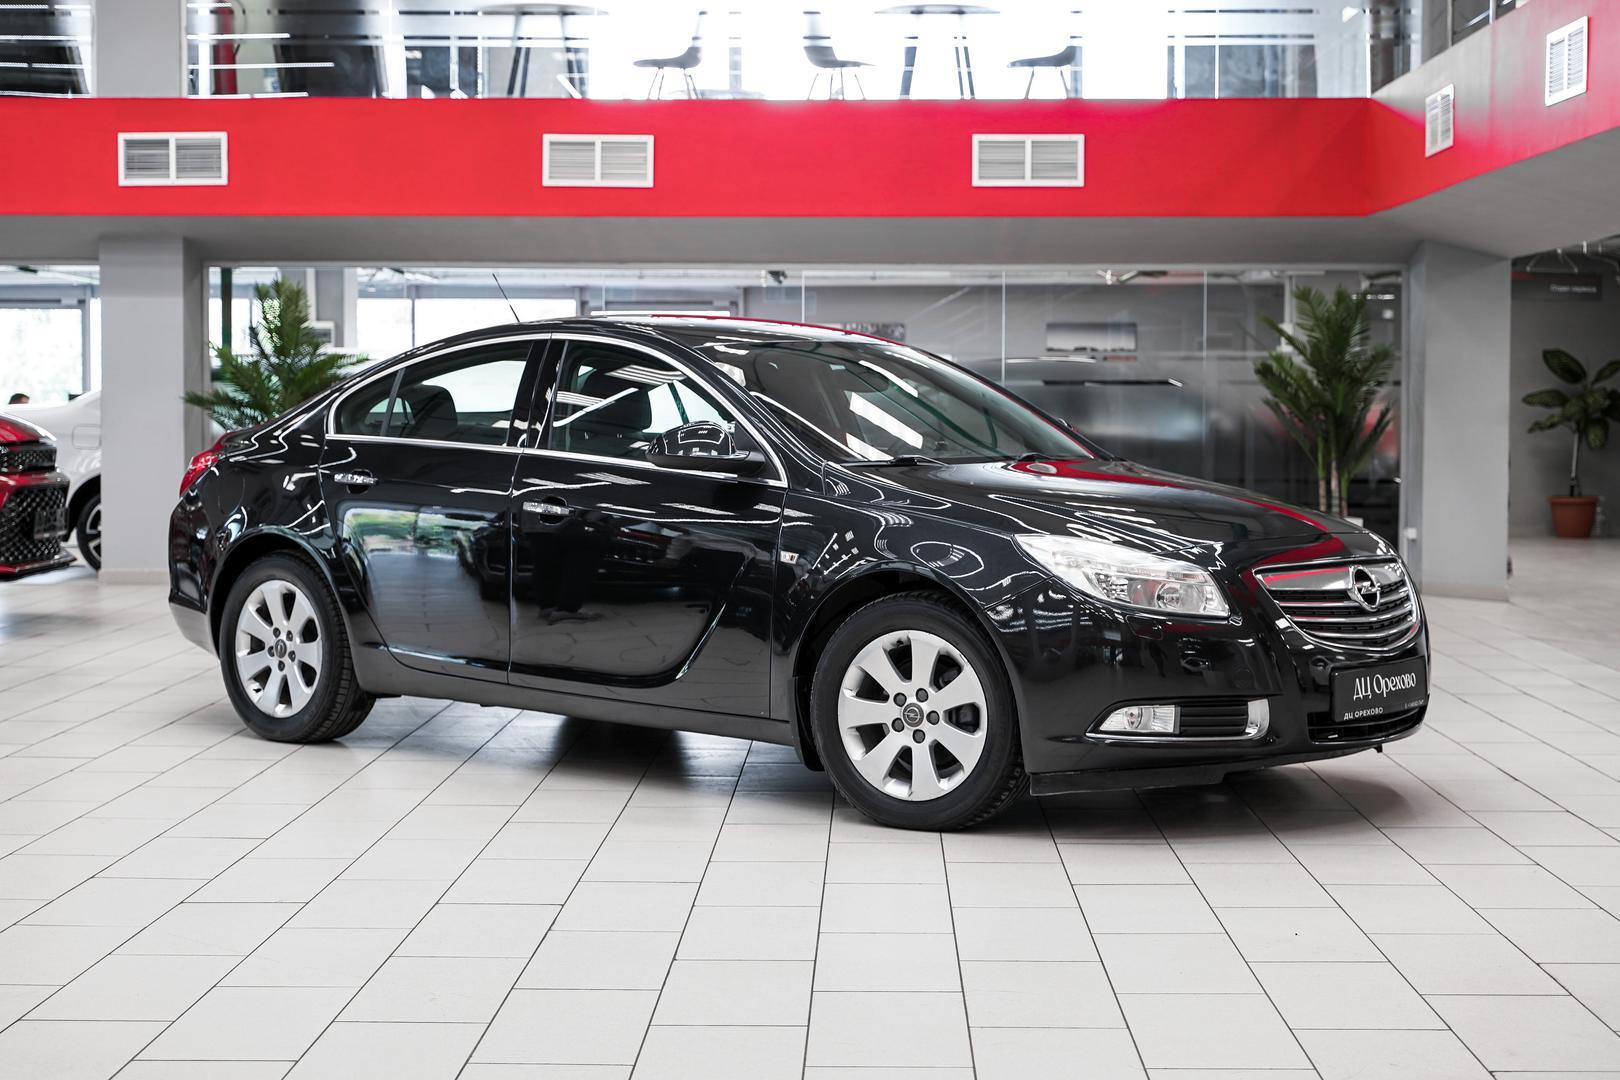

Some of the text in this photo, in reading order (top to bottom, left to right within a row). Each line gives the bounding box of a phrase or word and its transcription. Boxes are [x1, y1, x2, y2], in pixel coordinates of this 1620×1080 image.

[1353, 672, 1417, 701] ДЦ Орехово
[1343, 707, 1384, 720] ДЦ ОРЕХОВО
